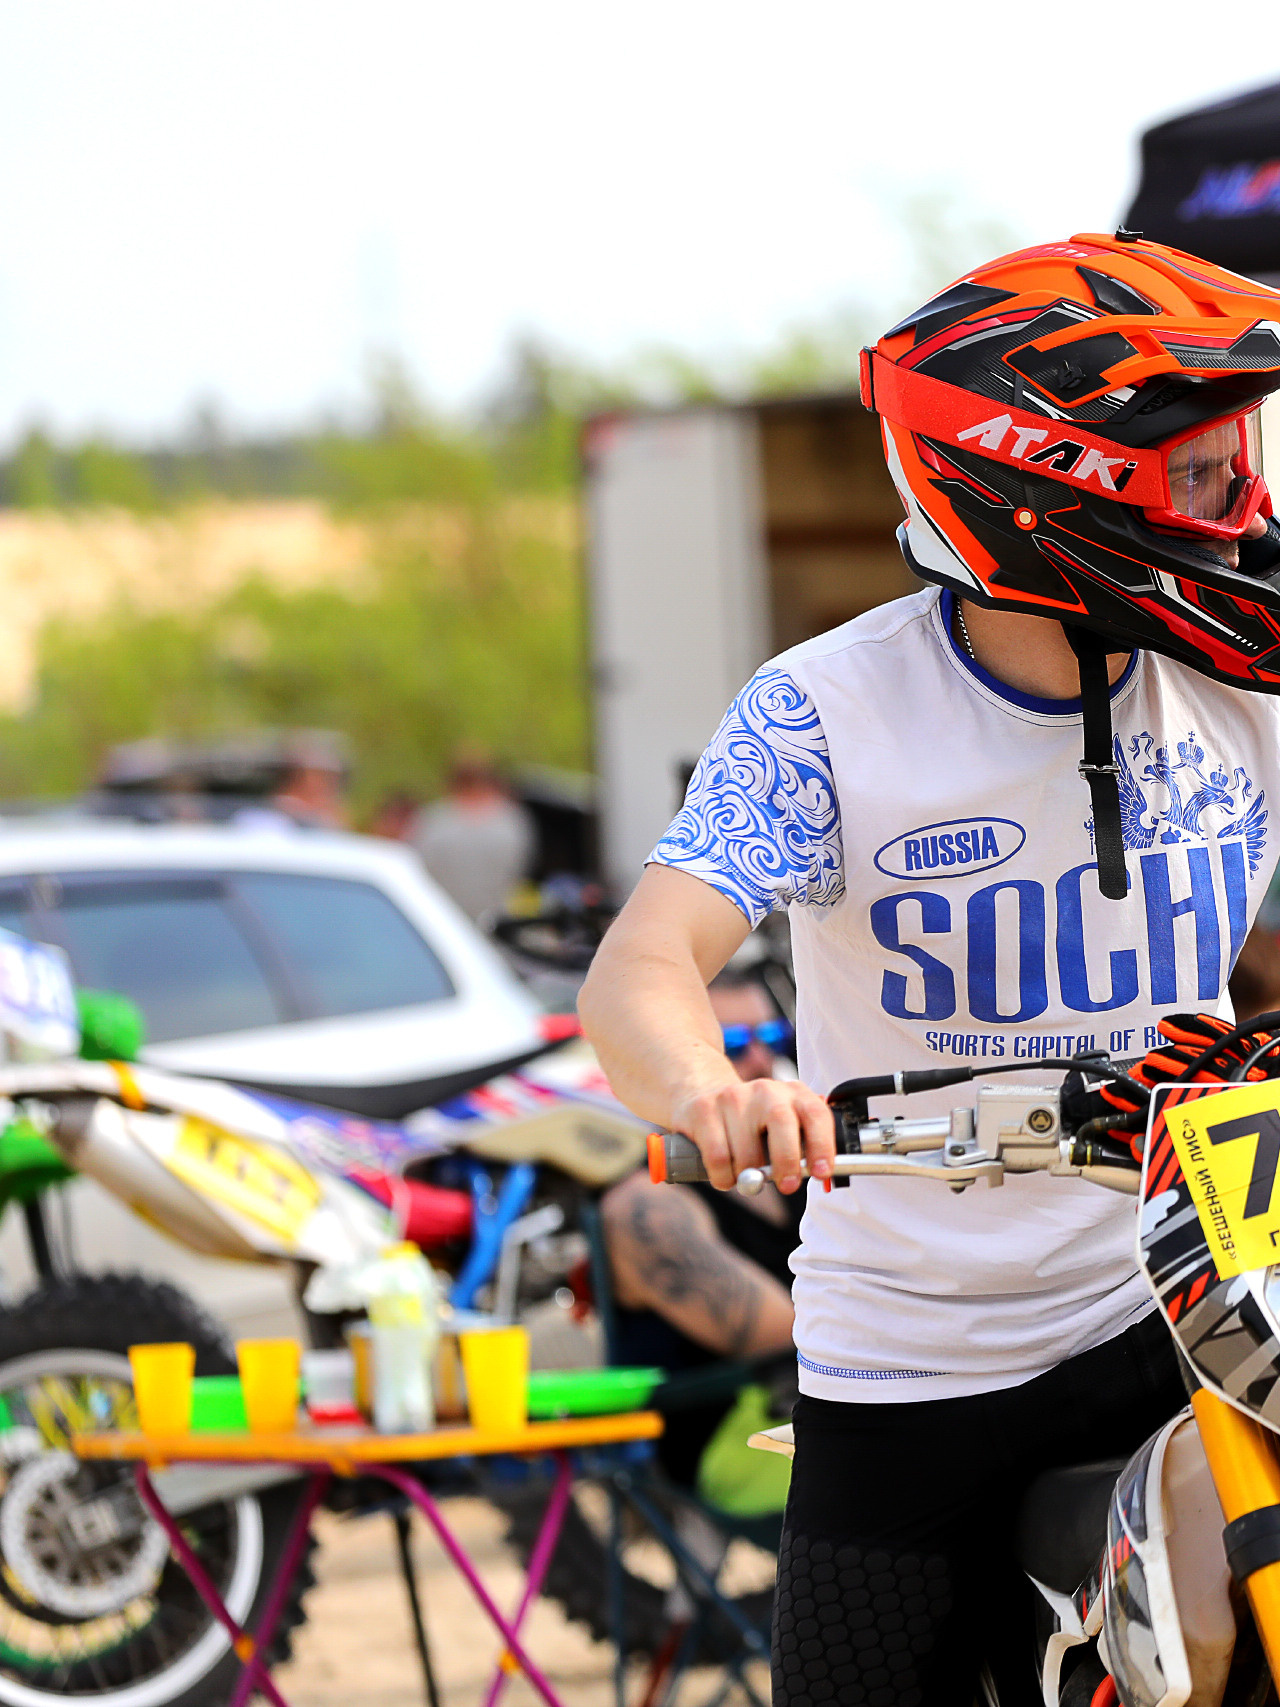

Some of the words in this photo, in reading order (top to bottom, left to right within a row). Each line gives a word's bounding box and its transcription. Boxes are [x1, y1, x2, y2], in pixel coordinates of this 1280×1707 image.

[904, 826, 1000, 871] RUSSIA
[869, 841, 1249, 1024] SOCHI
[925, 1031, 1005, 1057] SPORTS
[1013, 1034, 1096, 1058] CAPITAL
[1110, 1029, 1133, 1052] OF
